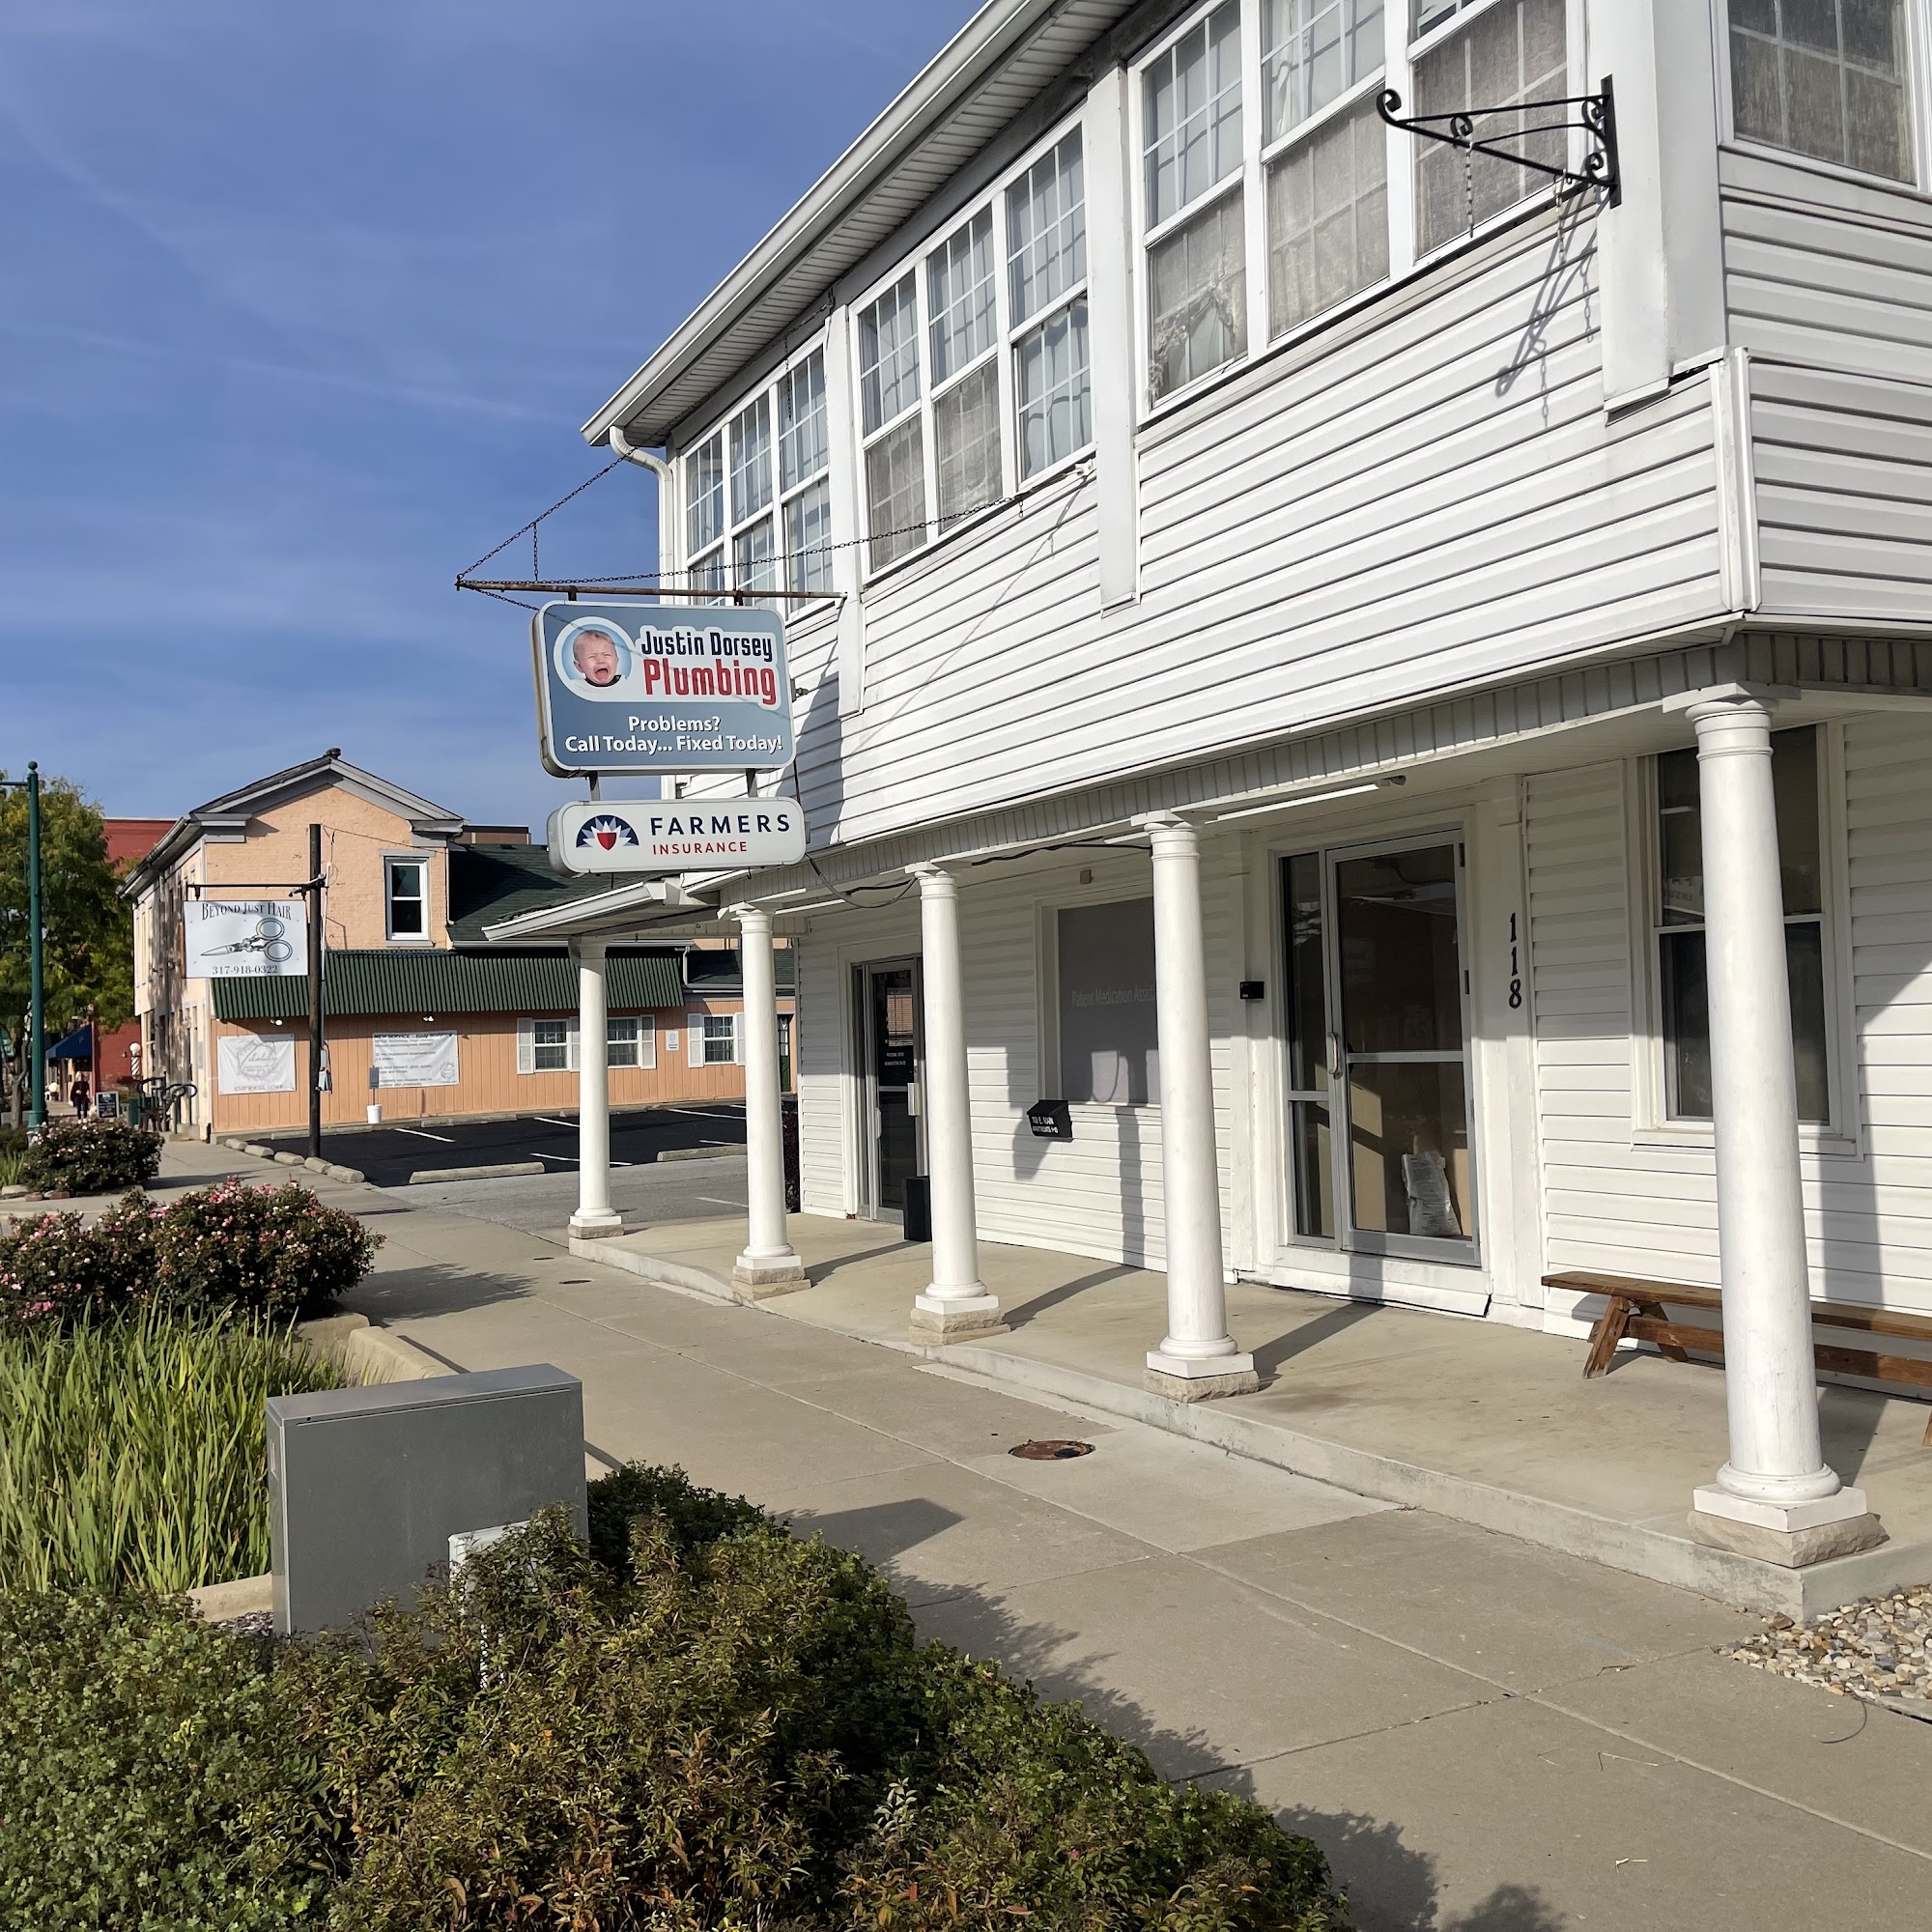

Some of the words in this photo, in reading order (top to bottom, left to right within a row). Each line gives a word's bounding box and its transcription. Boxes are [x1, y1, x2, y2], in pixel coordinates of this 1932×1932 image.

[641, 631, 704, 655] Justin
[710, 632, 773, 663] Dorsey
[643, 658, 777, 705] Plumbing
[628, 716, 722, 732] Problems?
[565, 735, 601, 753] Call
[603, 735, 673, 755] Today...
[676, 735, 724, 752] Fixed
[725, 735, 783, 754] Today!
[650, 813, 790, 837] FARMERS
[652, 841, 748, 855] INSURANCE
[212, 965, 278, 975] 317-918-0322
[1508, 912, 1522, 1009] 118
